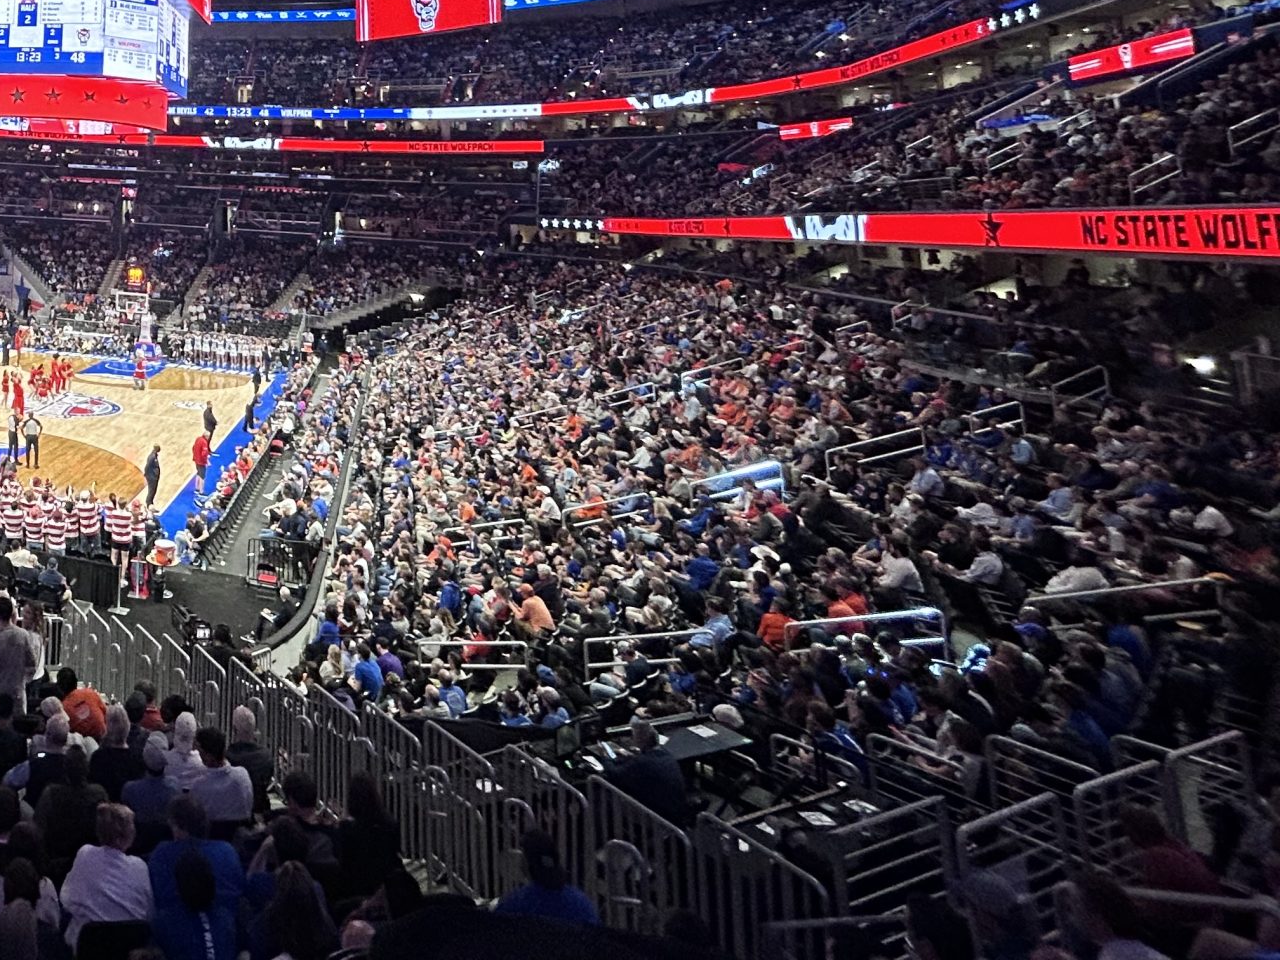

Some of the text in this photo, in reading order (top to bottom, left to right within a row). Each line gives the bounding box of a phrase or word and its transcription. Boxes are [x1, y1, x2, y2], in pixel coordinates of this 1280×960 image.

[20, 4, 36, 12] HALF
[24, 15, 32, 24] 2
[16, 52, 42, 62] 13:23
[70, 52, 86, 63] 48
[178, 107, 198, 115] DEVILS
[204, 108, 214, 116] 42
[226, 108, 252, 117] 13:23
[281, 109, 313, 117] WOLFPACK
[409, 143, 494, 151] NC STATE WOLFPACK
[1080, 213, 1280, 250] NC STATE WOLF
